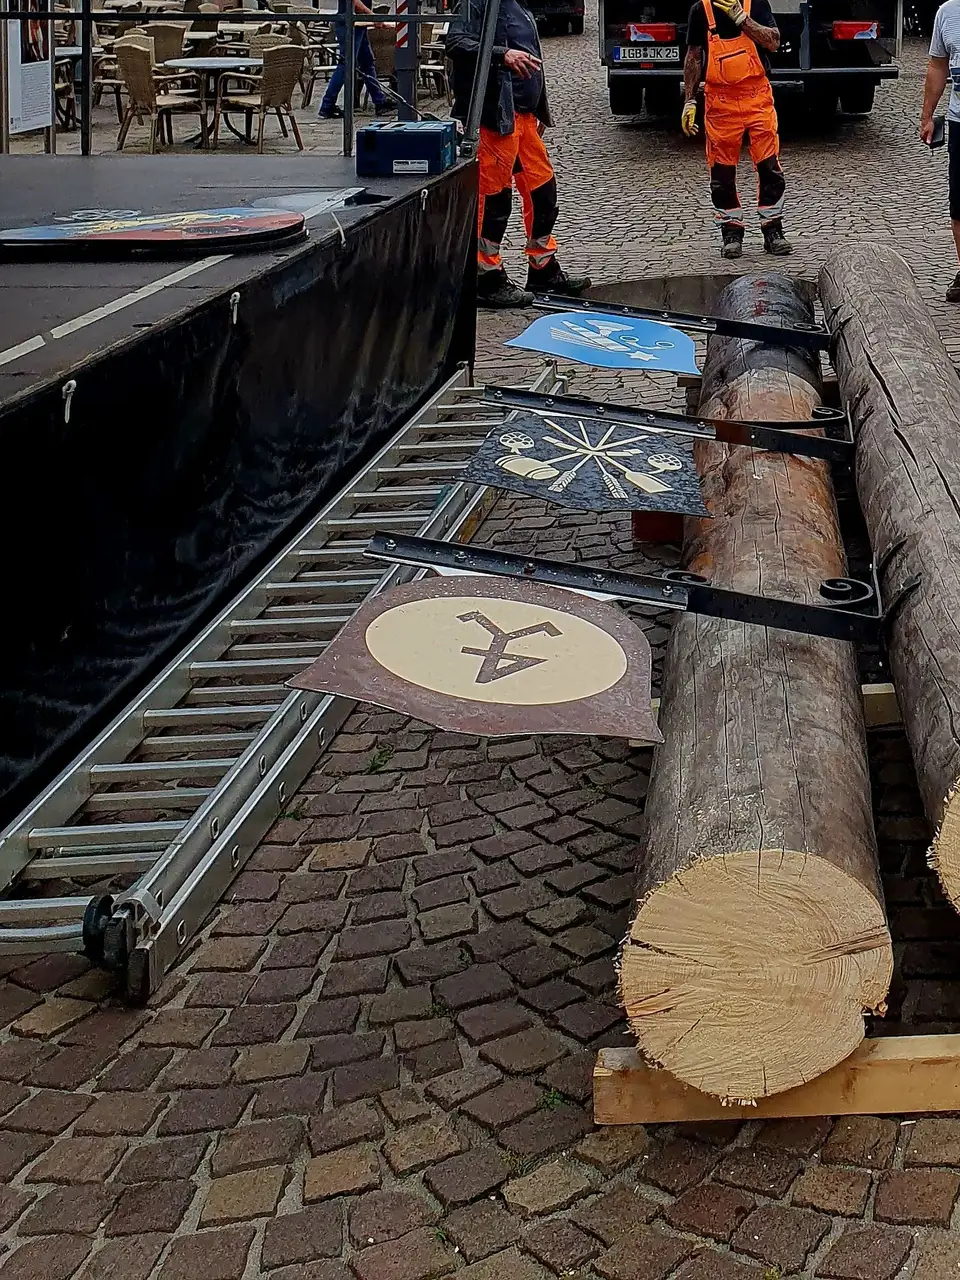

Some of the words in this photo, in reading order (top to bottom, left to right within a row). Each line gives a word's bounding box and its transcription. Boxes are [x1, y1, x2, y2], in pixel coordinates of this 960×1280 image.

[621, 47, 642, 59] IGB
[649, 47, 663, 59] JK
[665, 47, 678, 59] 25
